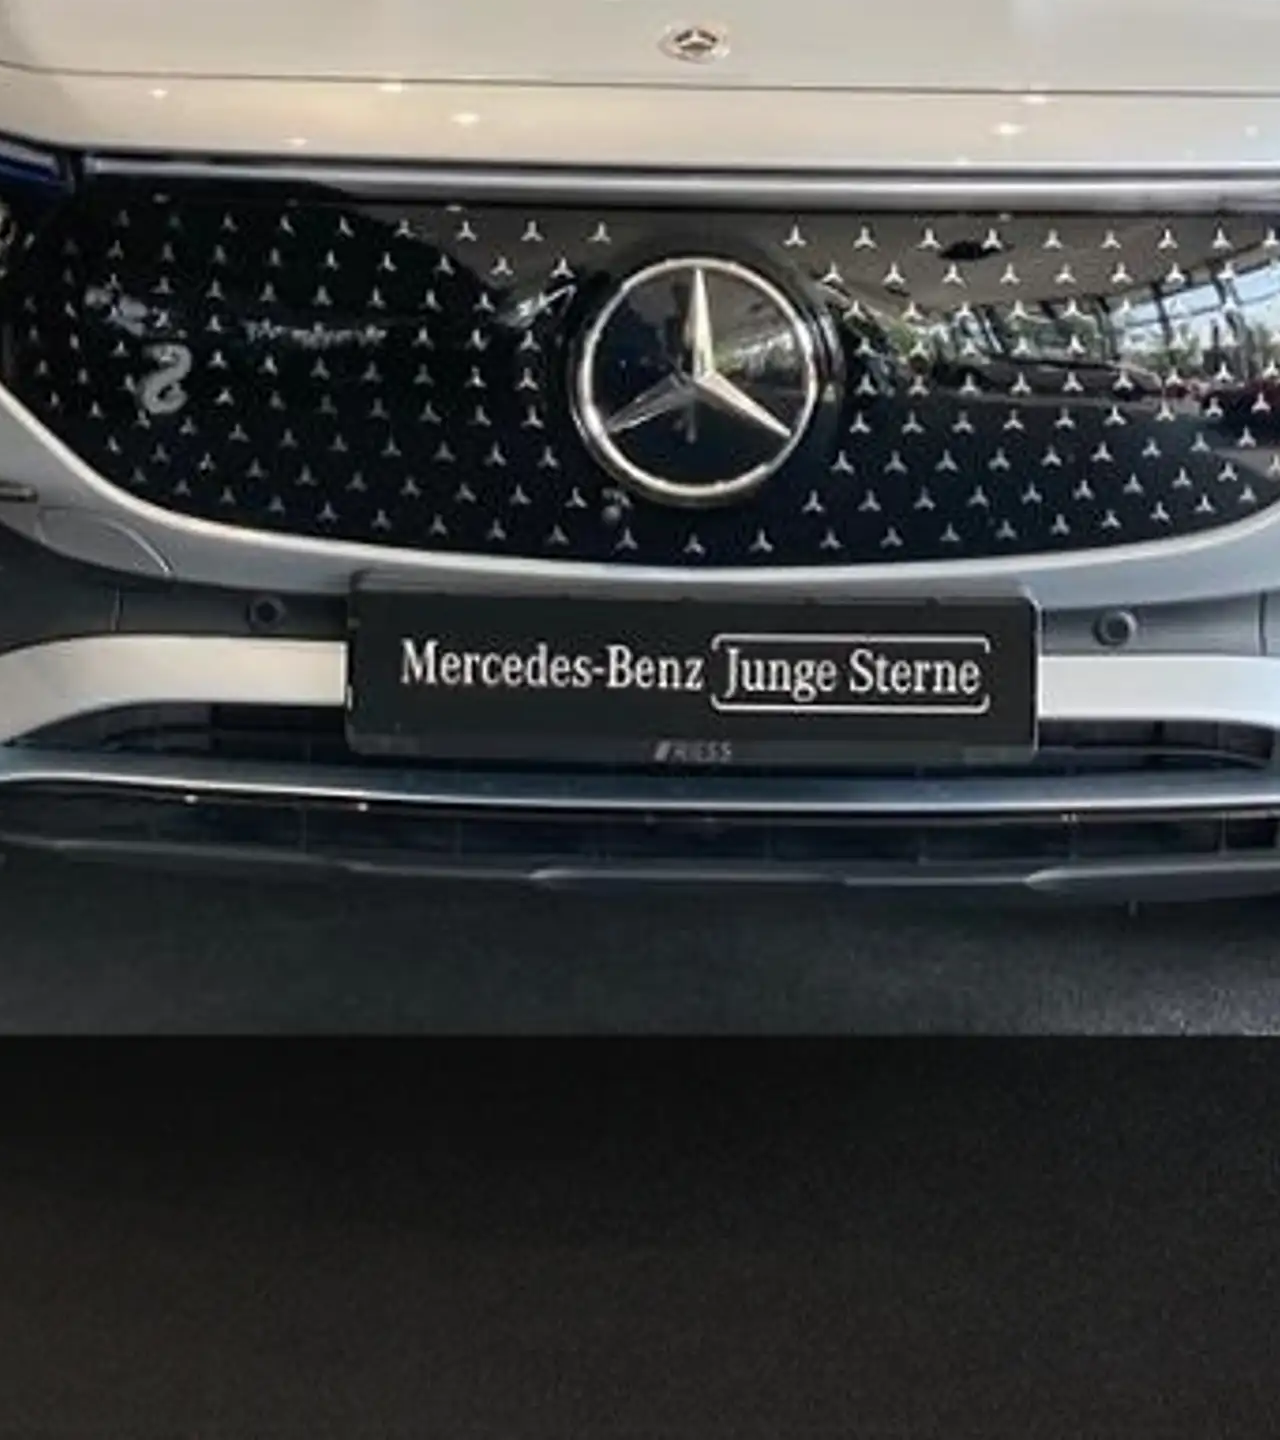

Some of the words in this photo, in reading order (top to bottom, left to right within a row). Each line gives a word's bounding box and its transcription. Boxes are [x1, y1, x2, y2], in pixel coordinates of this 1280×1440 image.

[400, 638, 706, 691] Mercedes-Benz
[722, 646, 837, 703] Junge
[848, 647, 981, 695] Sterne
